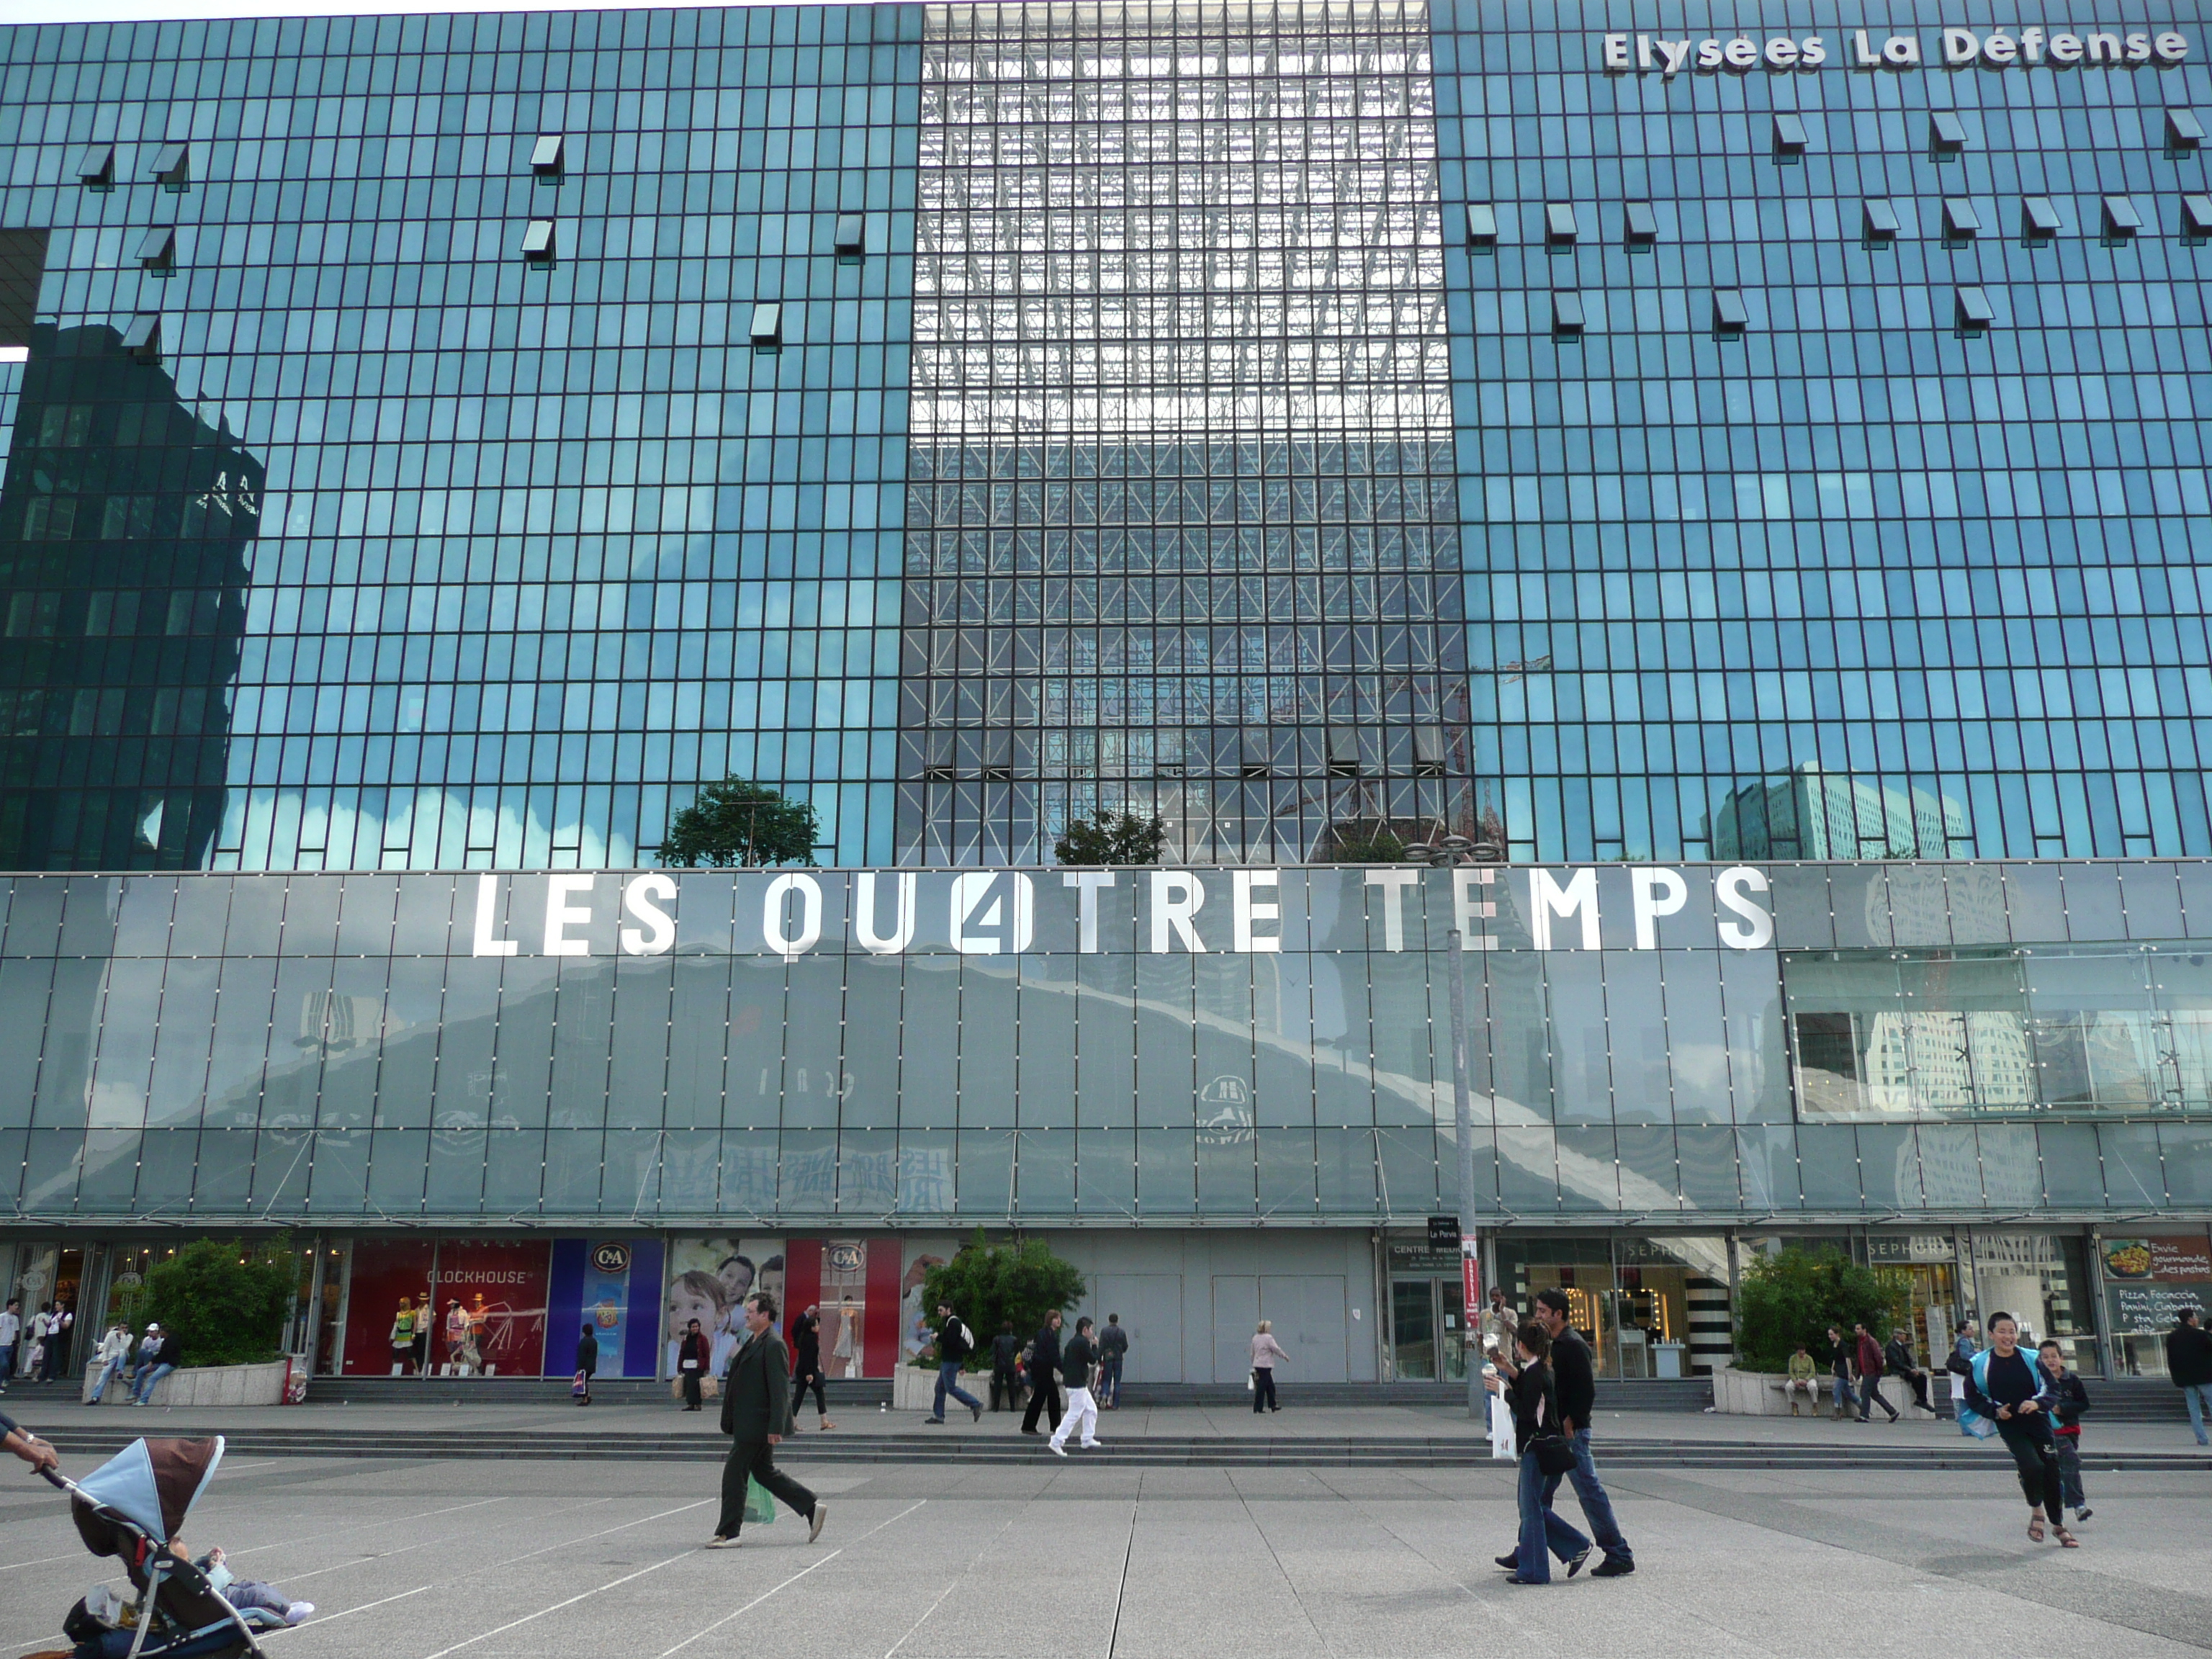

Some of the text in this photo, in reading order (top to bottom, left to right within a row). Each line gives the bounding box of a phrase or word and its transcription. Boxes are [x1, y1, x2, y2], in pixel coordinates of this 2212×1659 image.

[1604, 27, 2189, 74] Elysées La Défense
[472, 872, 678, 956] LES
[1365, 866, 1773, 952] TEMPS
[1394, 1245, 1430, 1254] CENTRE
[1869, 1243, 1949, 1255] SEPHORA
[2151, 1243, 2178, 1254] Envie
[598, 1250, 623, 1264] C&A
[834, 1250, 859, 1264] C&A
[2180, 1265, 2211, 1274] pastas
[427, 1271, 526, 1284] CLOCKHOUSE
[2119, 1288, 2199, 1300] Pizza, Focaccia,
[2121, 1301, 2206, 1312] Panini, Ciabatta,
